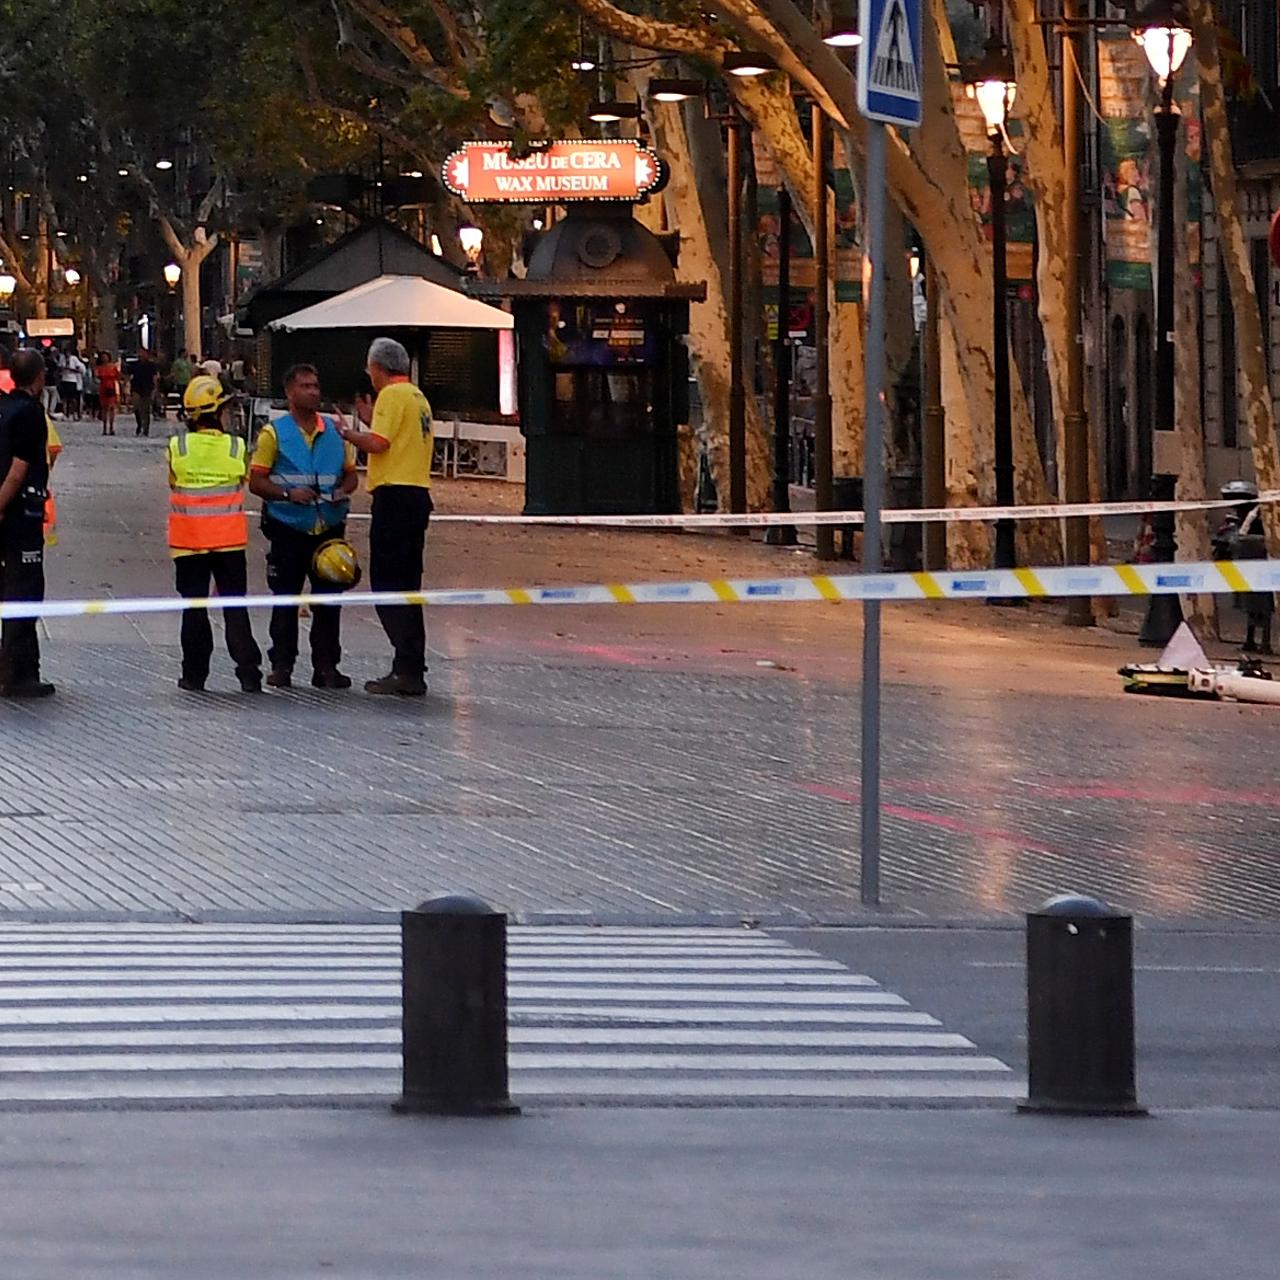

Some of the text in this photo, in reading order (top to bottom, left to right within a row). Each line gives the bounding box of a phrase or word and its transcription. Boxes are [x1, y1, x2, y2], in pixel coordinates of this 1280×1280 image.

[570, 151, 621, 169] CERA
[495, 175, 608, 191] WAX MUSEUM
